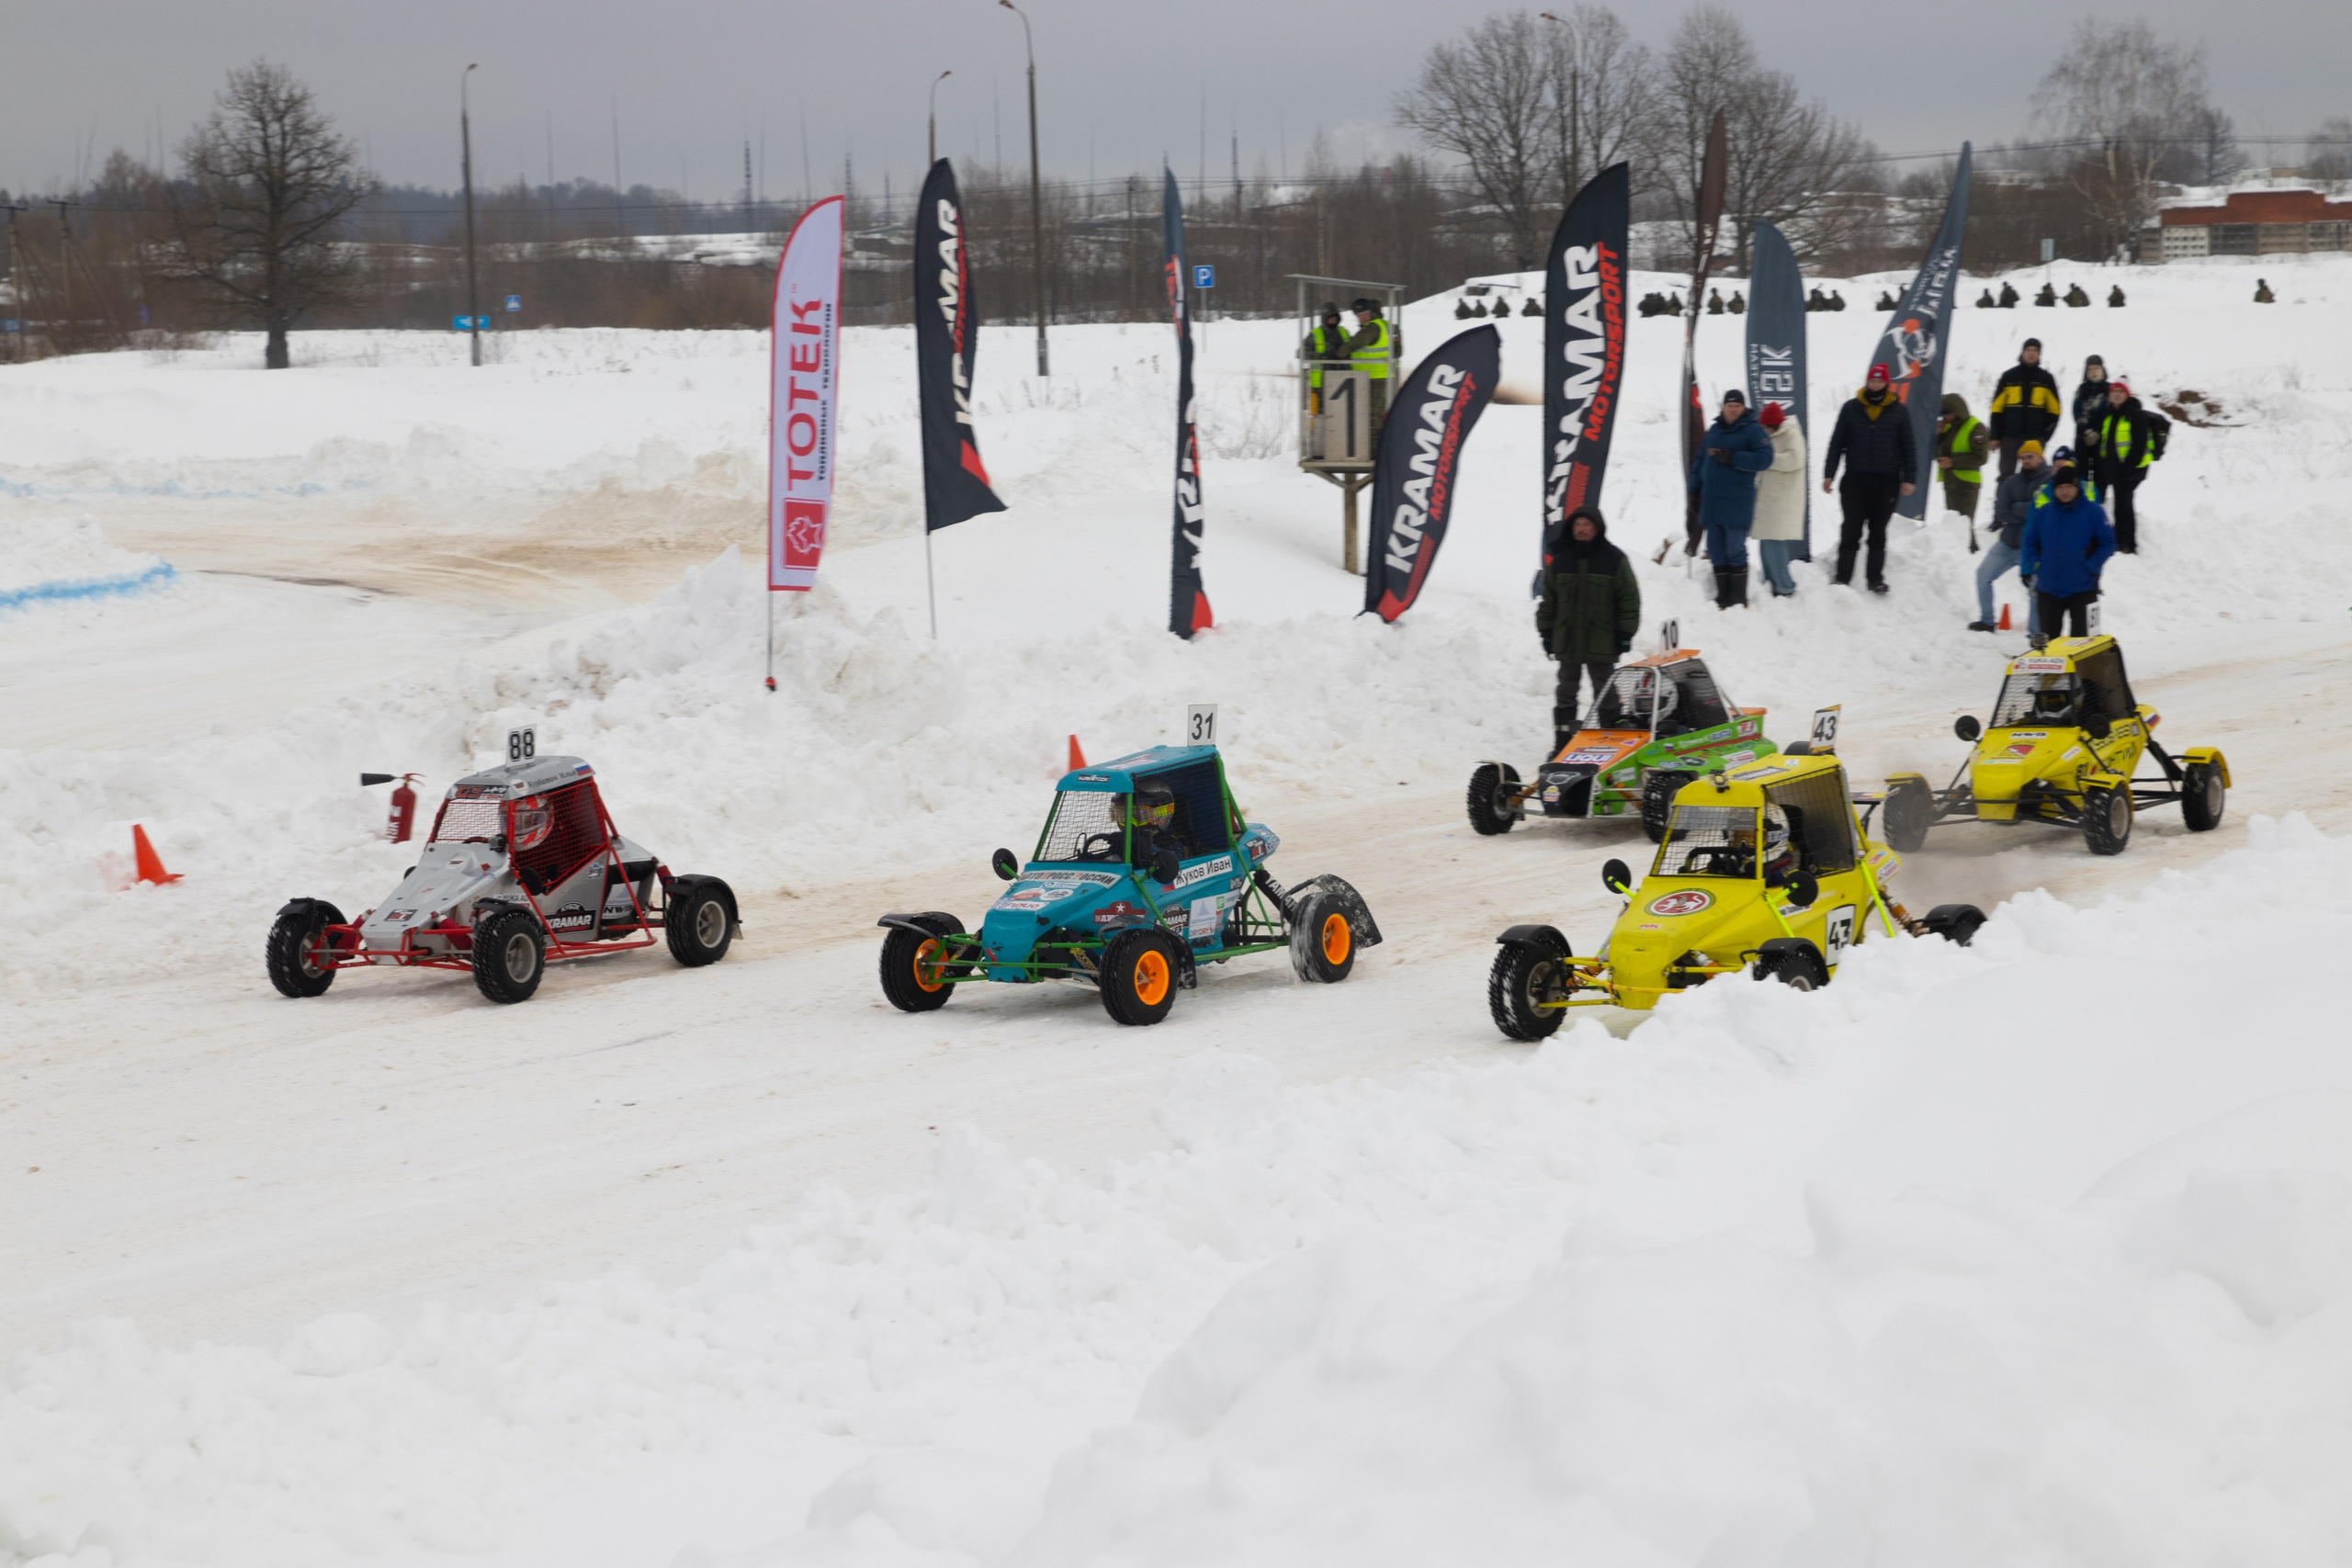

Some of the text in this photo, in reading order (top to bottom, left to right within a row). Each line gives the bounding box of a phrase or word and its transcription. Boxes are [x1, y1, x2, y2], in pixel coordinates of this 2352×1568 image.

[1583, 241, 1623, 442] MOTORSPORT
[1329, 377, 1355, 458] 1
[1429, 372, 1476, 522] MOTORSPORT
[1385, 364, 1467, 573] KRAMAR
[1663, 620, 1679, 650] 10
[1192, 712, 1214, 740] 31
[1814, 716, 1837, 742] 43
[510, 728, 535, 762] 88
[1072, 873, 1116, 885] РОССИИ
[1176, 858, 1232, 886] Жуков Иван
